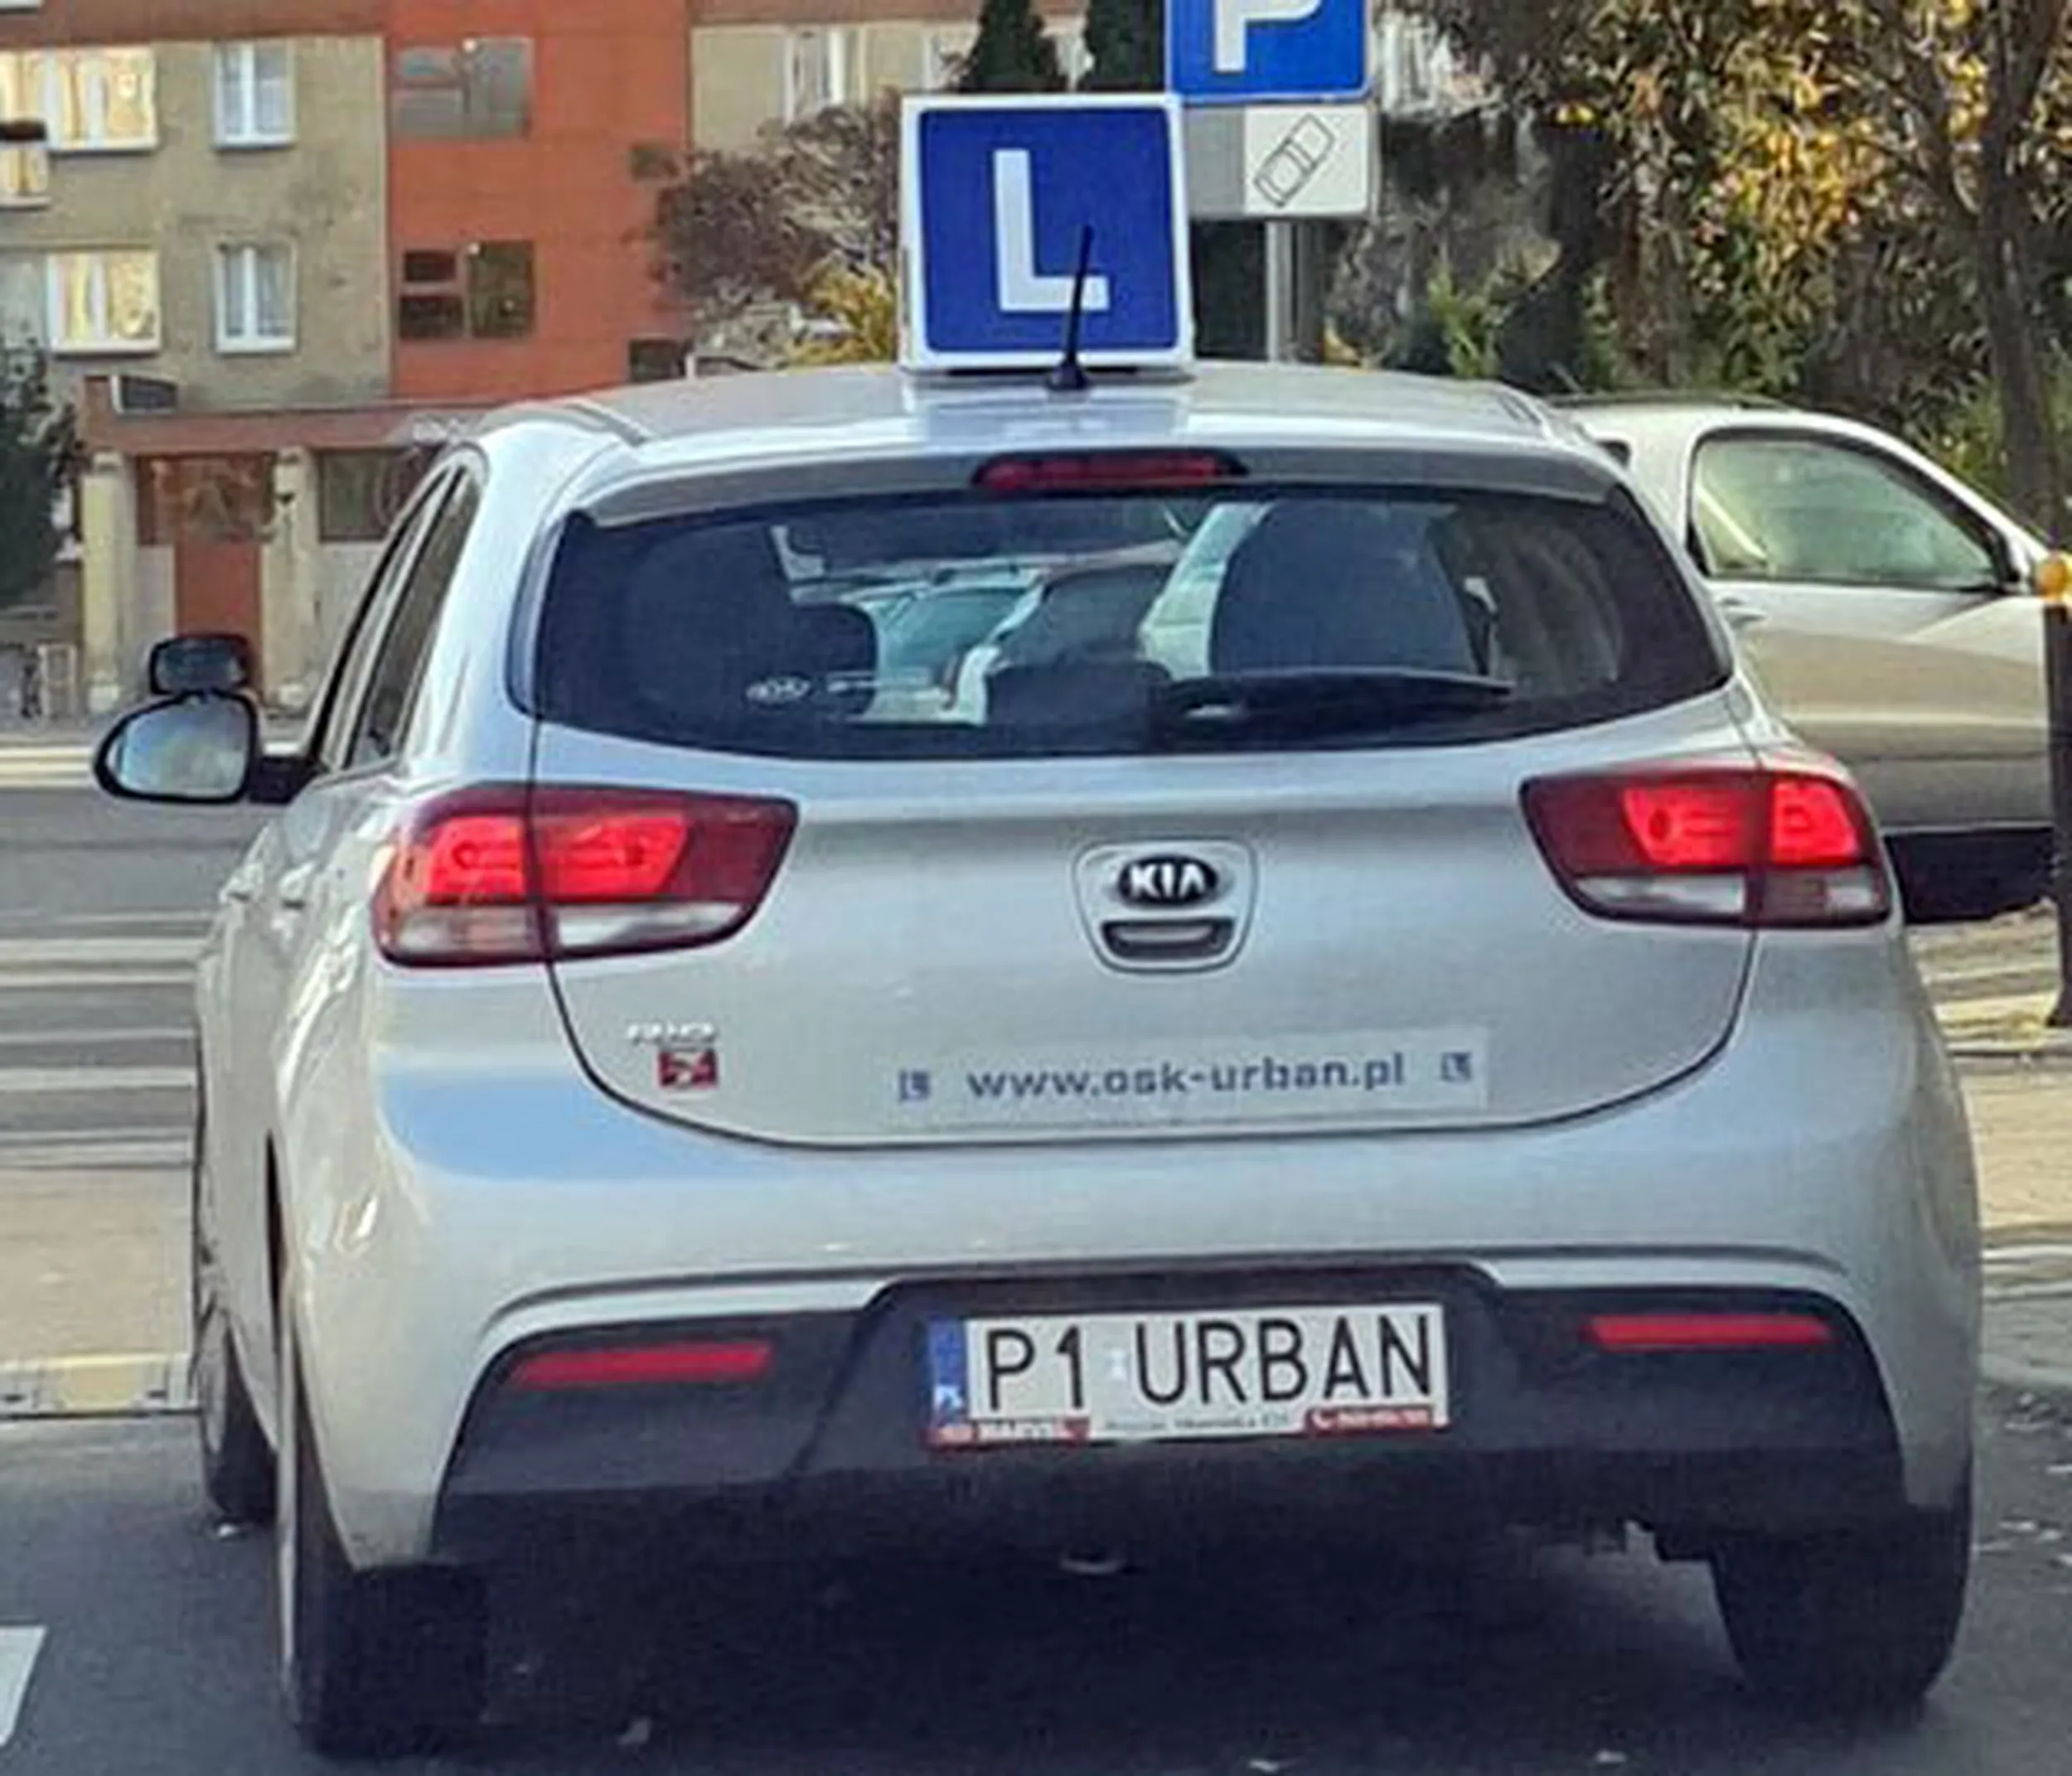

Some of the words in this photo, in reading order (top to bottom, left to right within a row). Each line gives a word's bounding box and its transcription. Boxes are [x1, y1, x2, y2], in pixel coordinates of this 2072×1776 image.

[995, 148, 1109, 311] L
[1130, 863, 1204, 898] KIA
[966, 1052, 1403, 1098] www.osk-urban.pl
[985, 1327, 1084, 1411] P1
[1135, 1315, 1431, 1405] URBAN
